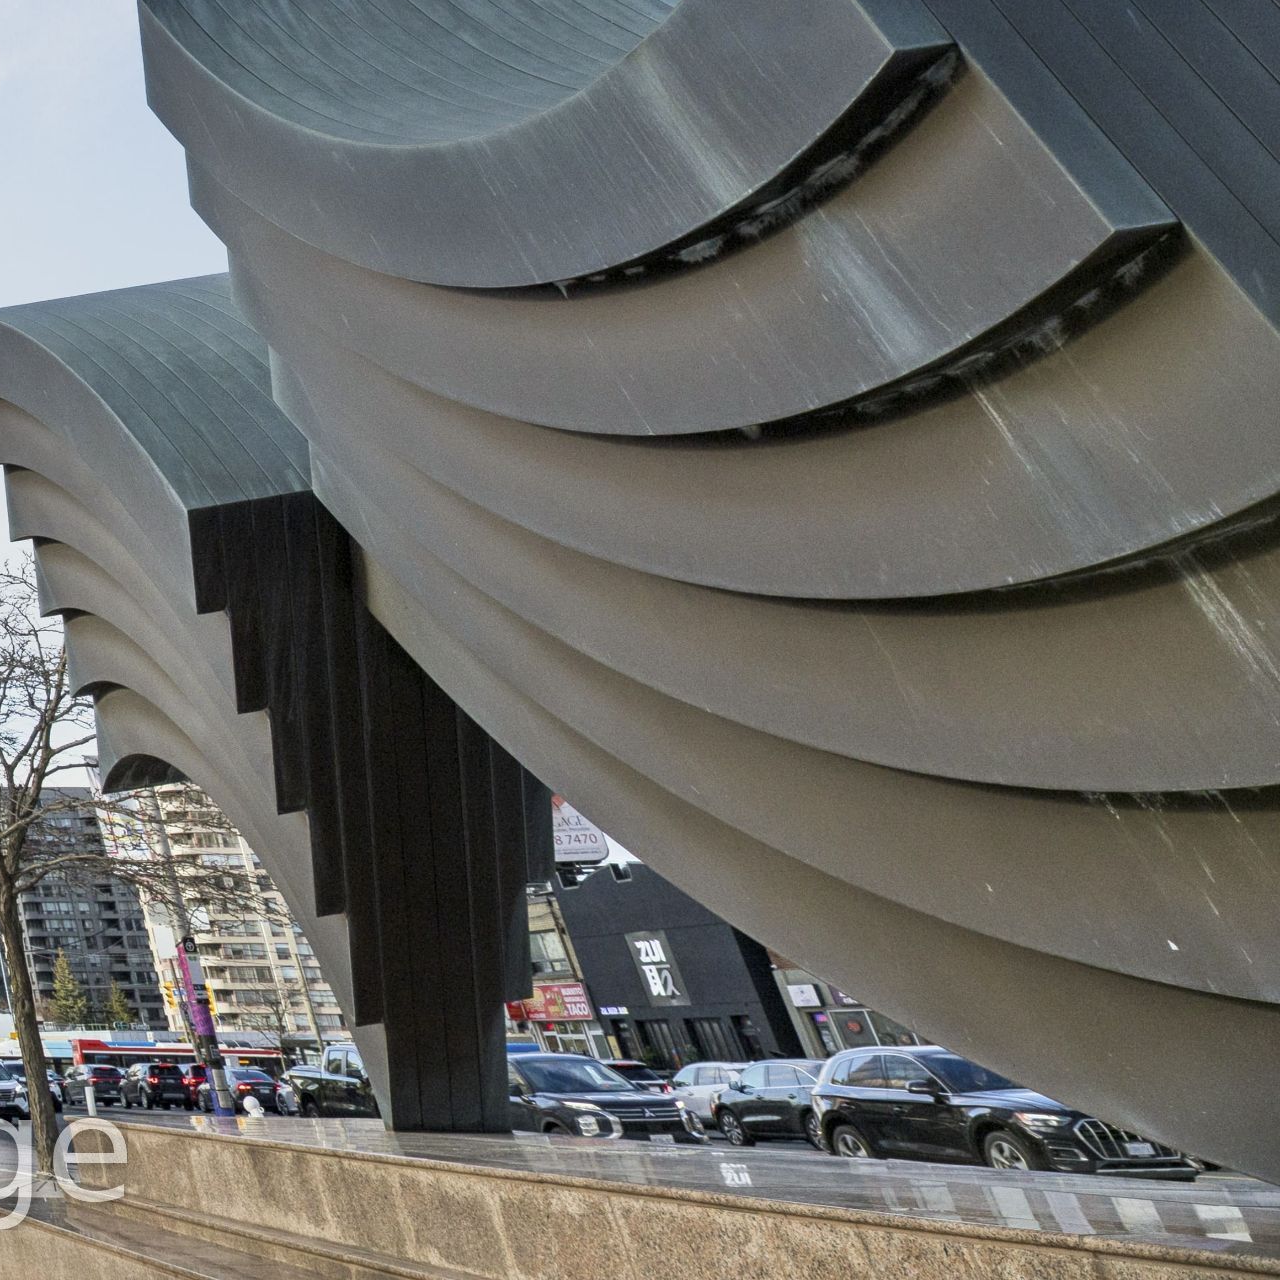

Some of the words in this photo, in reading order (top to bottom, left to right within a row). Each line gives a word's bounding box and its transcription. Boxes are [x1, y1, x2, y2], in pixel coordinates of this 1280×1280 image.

[564, 833, 598, 845] 7470
[634, 939, 667, 963] ZUI
[566, 1003, 589, 1016] TACO
